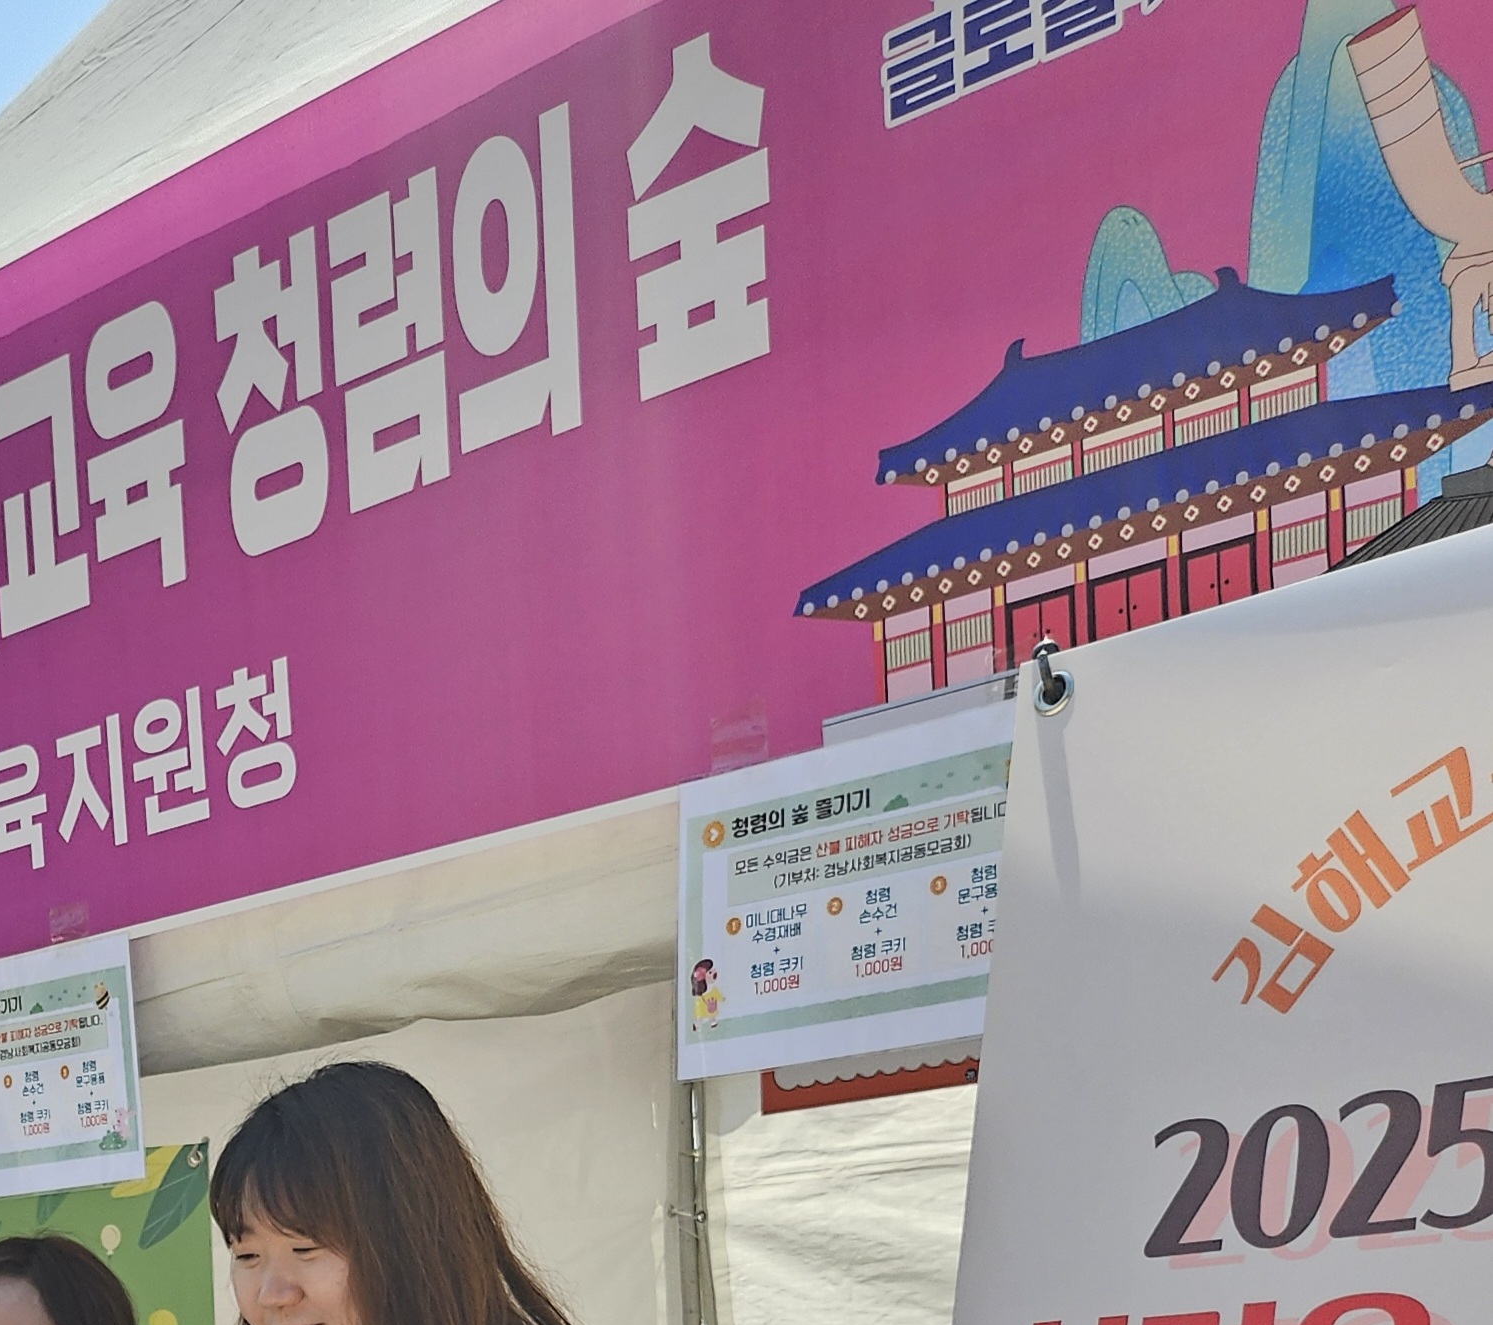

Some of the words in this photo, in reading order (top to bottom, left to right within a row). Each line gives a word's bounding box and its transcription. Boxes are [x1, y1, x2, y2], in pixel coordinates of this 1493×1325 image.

[212, 101, 583, 557] 청렴의
[626, 31, 773, 402] 숲
[731, 807, 785, 839] 청렴의
[792, 803, 809, 826] 숲
[815, 787, 870, 821] 즐기기
[734, 857, 759, 876] 모든
[763, 845, 812, 869] 수익금은
[816, 840, 841, 859] 산불
[845, 829, 884, 852] 피해자
[888, 817, 940, 843] 성금으로
[773, 866, 820, 889] (기부처:
[824, 833, 972, 879] 경남사회복지공동모금회)
[971, 863, 997, 884] 청렴
[865, 886, 891, 905] 청렴
[745, 903, 808, 929] 미니대나무
[859, 902, 898, 924] 손수건
[752, 921, 802, 943] 수경재배
[956, 922, 983, 942] 청렴
[851, 943, 876, 961] 청렴
[880, 937, 906, 955] 쿠키
[750, 961, 775, 979] 청렴
[778, 955, 804, 973] 쿠키
[1143, 1075, 1493, 1258] 2025
